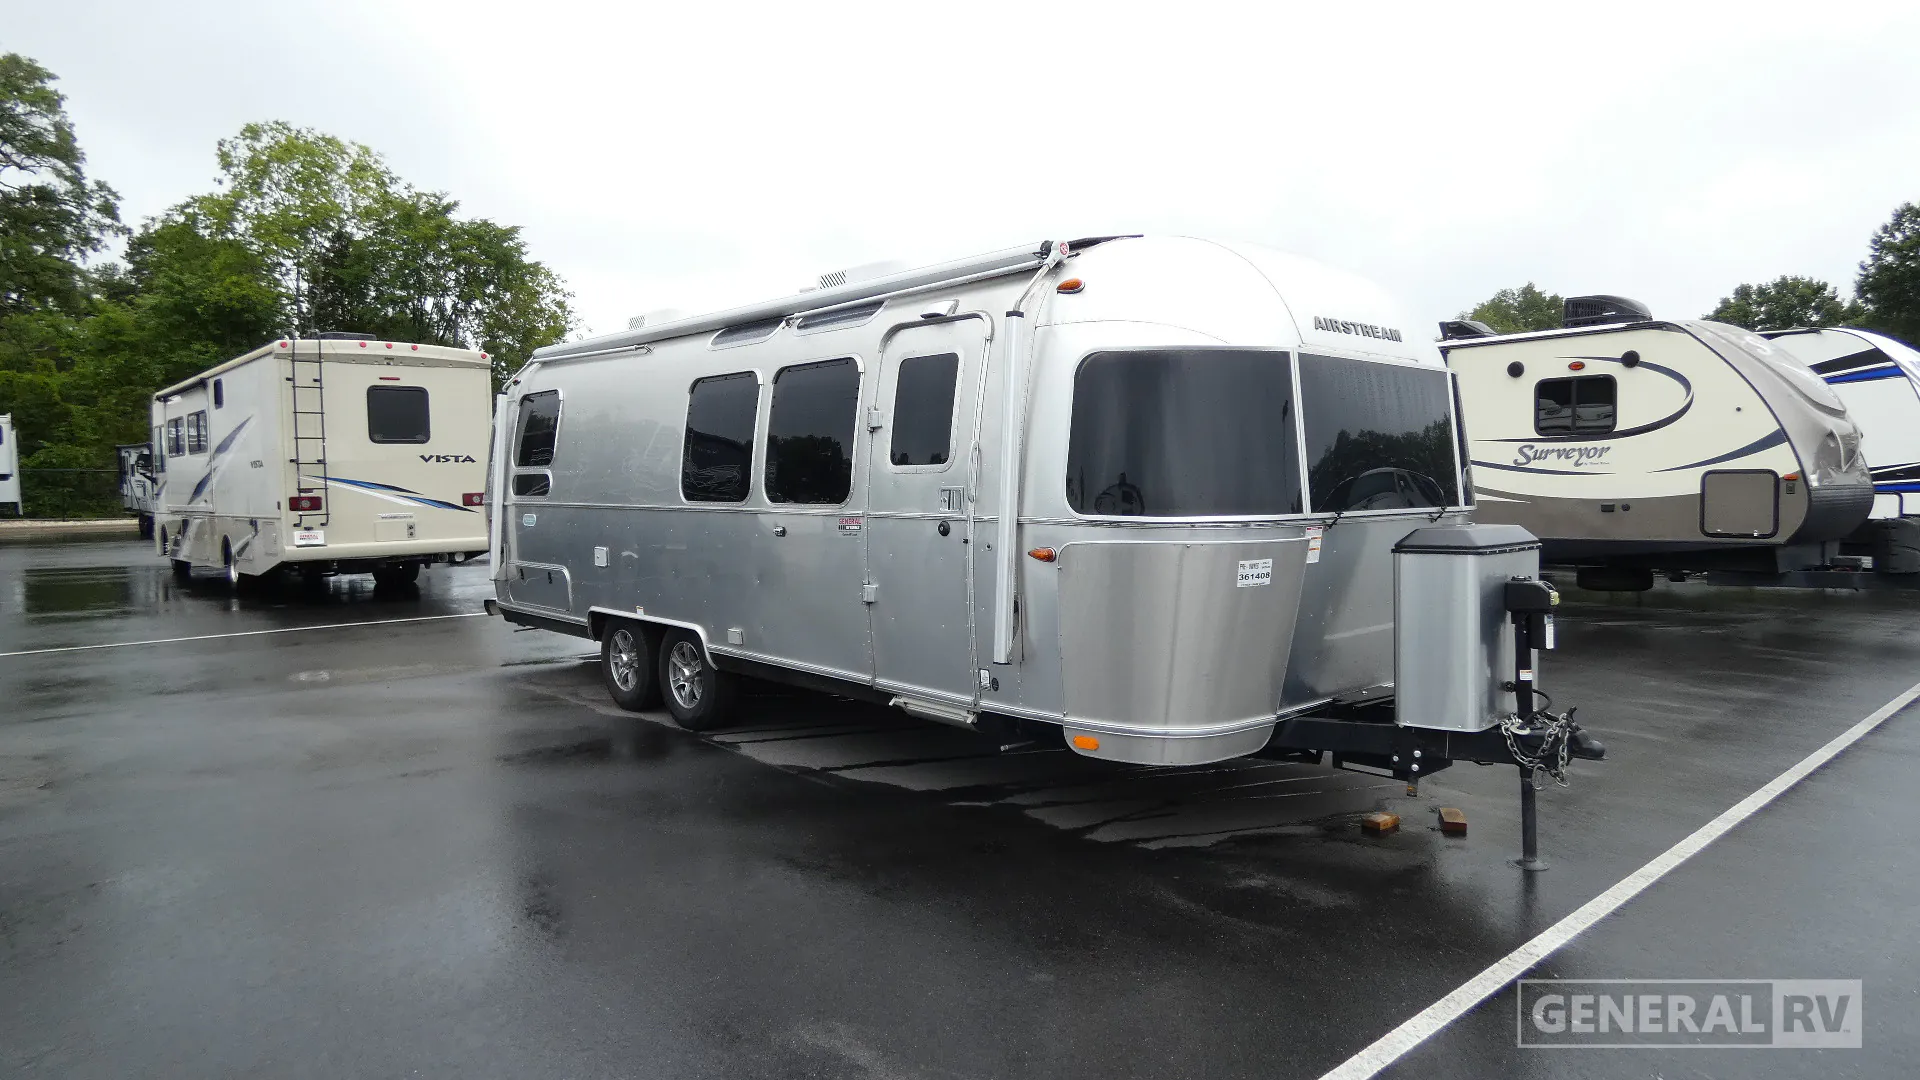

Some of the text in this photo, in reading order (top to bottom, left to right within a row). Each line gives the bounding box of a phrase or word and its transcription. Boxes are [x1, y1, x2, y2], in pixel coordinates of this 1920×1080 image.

[1314, 315, 1403, 342] AIRSTREAM
[419, 454, 476, 463] VISTA
[1512, 444, 1611, 467] Surveyor
[1239, 572, 1270, 580] 361408
